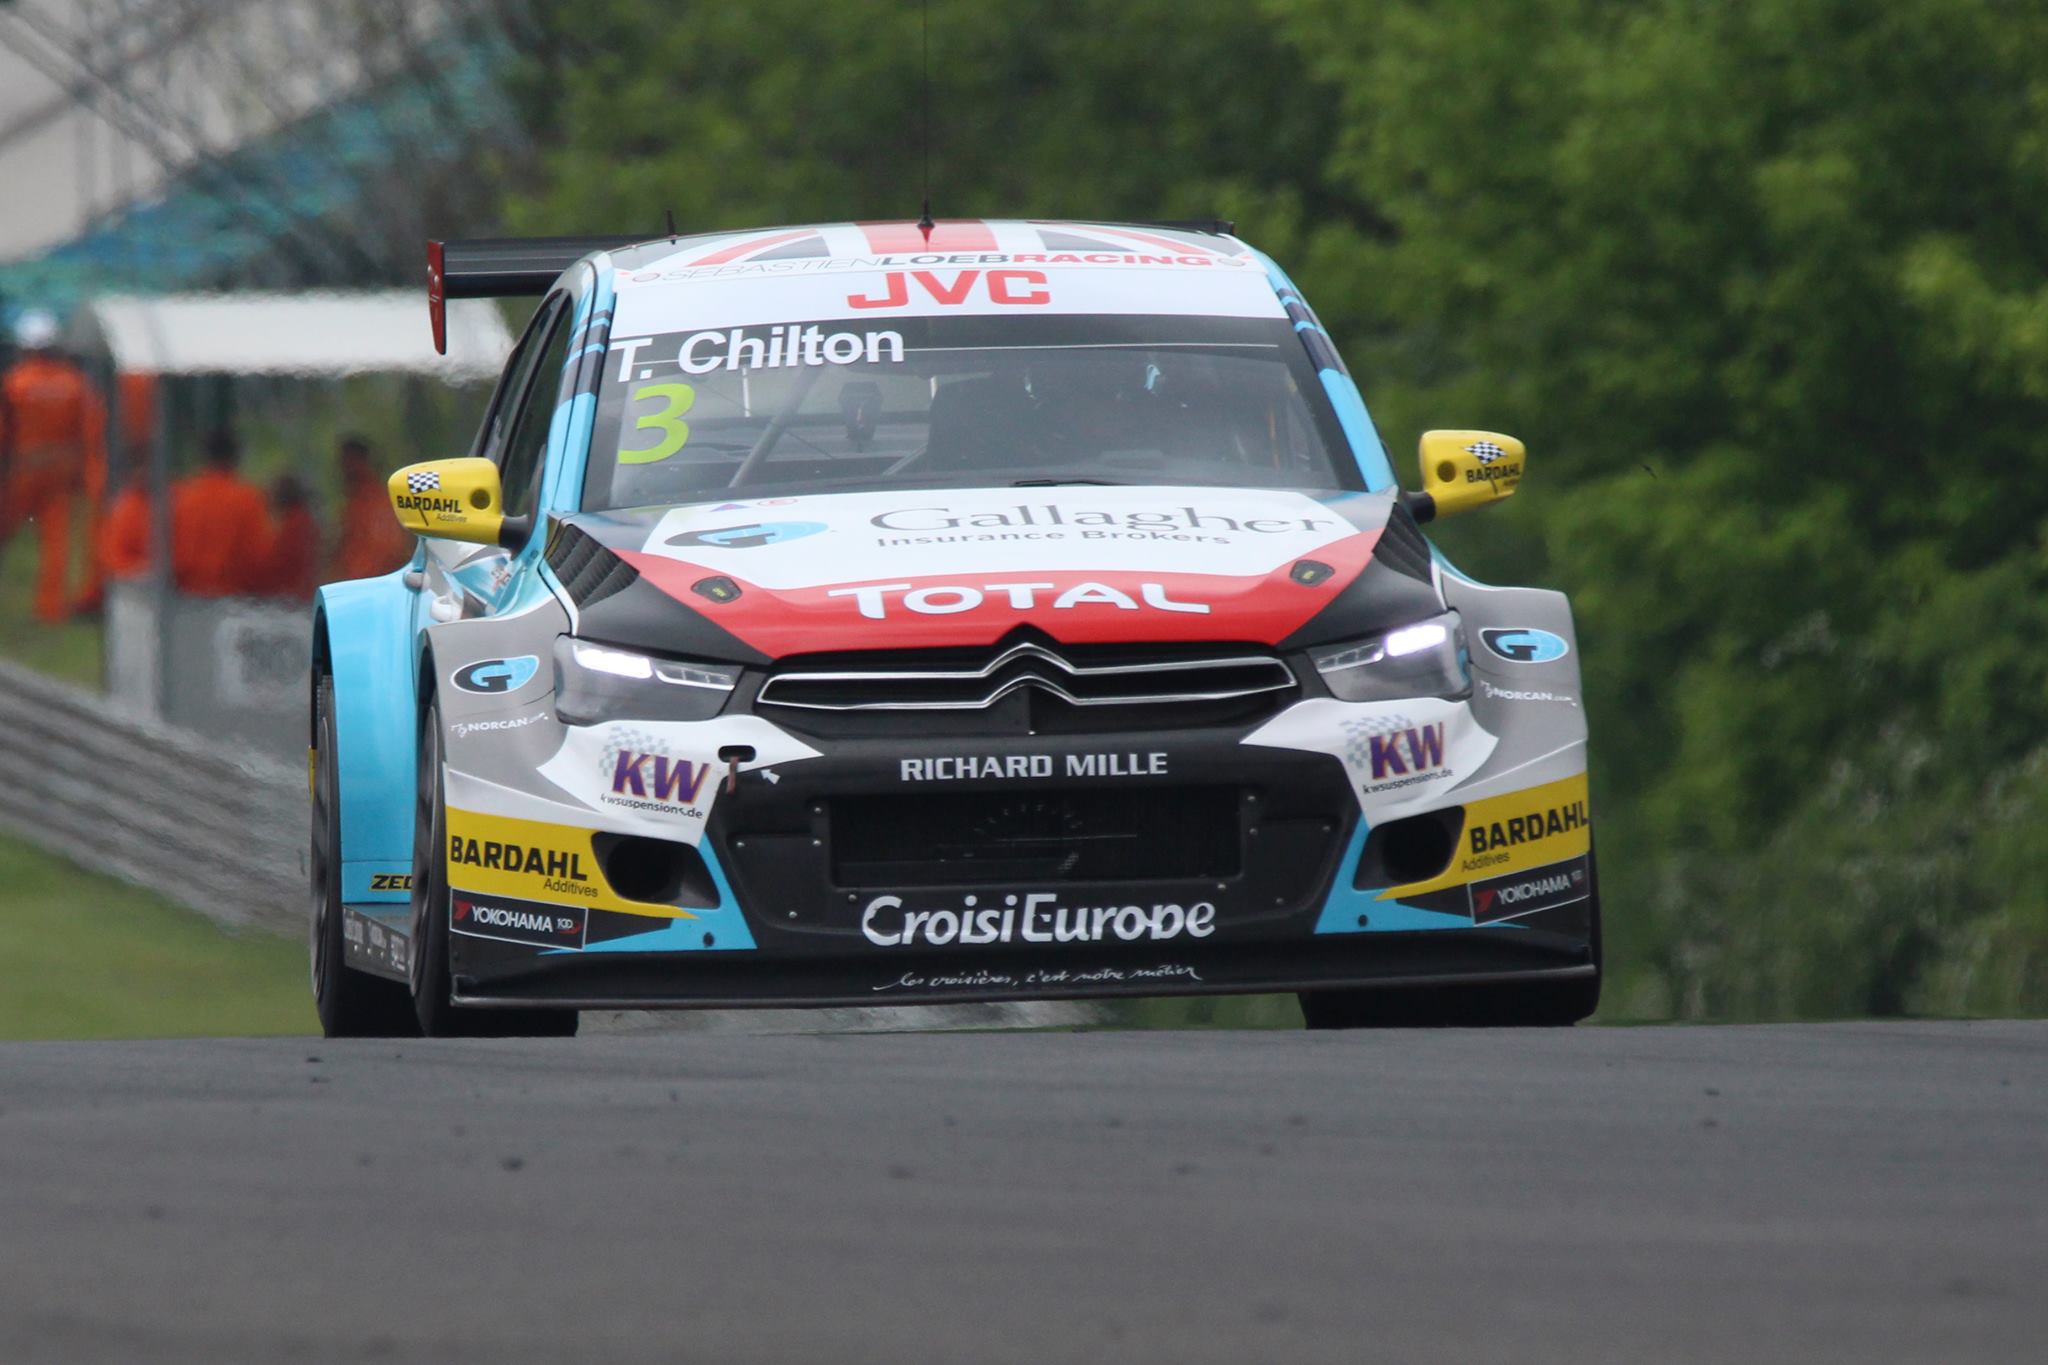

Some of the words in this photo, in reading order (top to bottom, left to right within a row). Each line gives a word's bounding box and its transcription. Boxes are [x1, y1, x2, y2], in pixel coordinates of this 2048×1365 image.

[847, 270, 1051, 309] JVC
[610, 336, 653, 383] T.
[677, 324, 905, 374] Chilton
[617, 382, 695, 465] 3
[397, 495, 462, 513] BARDAHL
[869, 504, 1335, 534] Gallagher
[877, 532, 1065, 547] Insurance
[1082, 530, 1231, 545] Brokers
[827, 581, 1212, 619] TOTAL
[1493, 687, 1553, 701] NORCAN
[468, 716, 528, 732] NORCAN
[900, 756, 1053, 782] RICHARD
[1066, 752, 1168, 777] MILLE
[1369, 720, 1443, 780] KW
[612, 748, 711, 806] KW
[1470, 800, 1589, 855] BARDAHL
[450, 834, 587, 882] BARDAHL
[543, 877, 599, 898] Additives
[1496, 874, 1571, 905] YOKOHAMA
[471, 905, 553, 933] YOKOHAMA
[862, 893, 1216, 946] CroisiEurope
